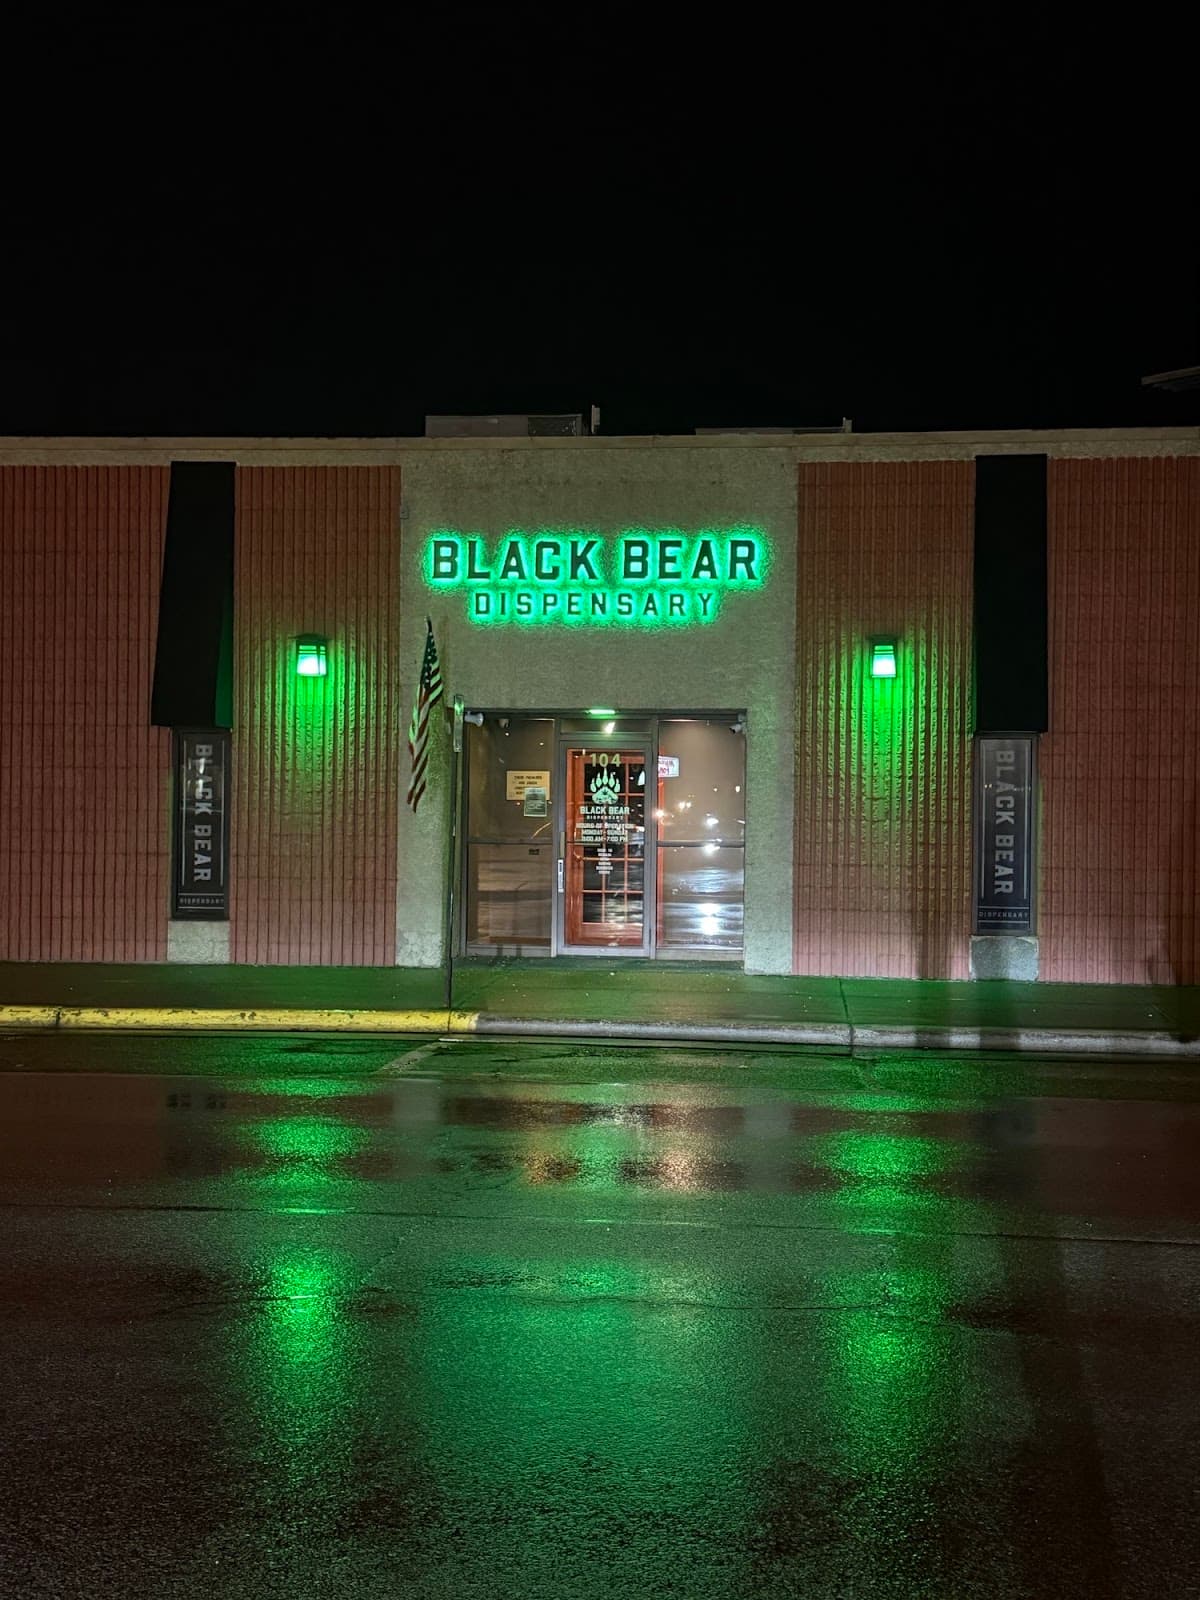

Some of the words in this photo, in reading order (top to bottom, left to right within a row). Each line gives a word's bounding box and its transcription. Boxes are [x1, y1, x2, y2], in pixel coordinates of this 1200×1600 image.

[432, 539, 599, 580] BLACK
[623, 539, 758, 580] BEAR
[475, 592, 714, 616] DISPENSARY
[592, 753, 622, 767] 104
[995, 750, 1015, 825] BLACK
[580, 806, 606, 815] BLACK
[608, 806, 630, 815] BEAR
[193, 825, 212, 882] BEAR
[994, 835, 1015, 895] BEAR
